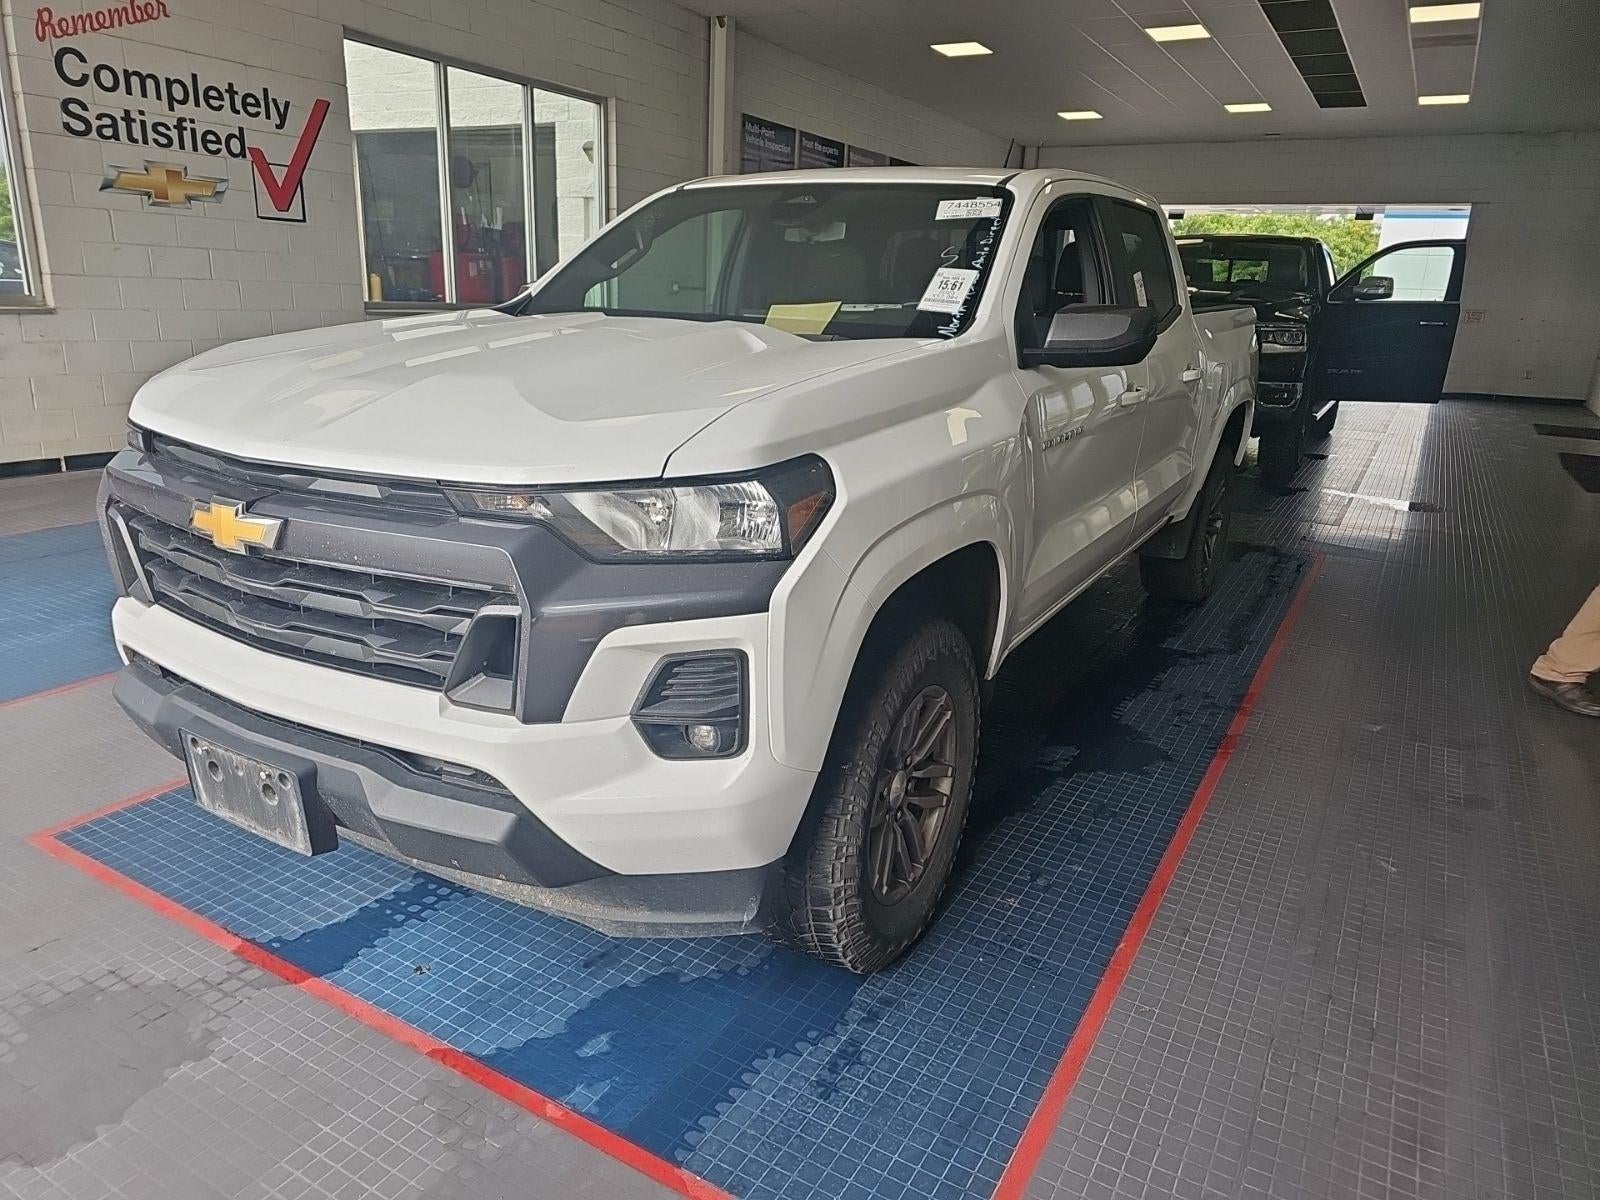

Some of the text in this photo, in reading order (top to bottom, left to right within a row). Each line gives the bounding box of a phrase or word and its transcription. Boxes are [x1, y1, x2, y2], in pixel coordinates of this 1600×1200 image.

[35, 0, 170, 42] Remember
[54, 46, 291, 130] Completely
[60, 97, 247, 159] Satisfied
[744, 121, 775, 138] Multi-Point
[745, 132, 791, 154] Vehicle Inspection
[802, 136, 814, 149] Trust
[822, 145, 839, 157] experts
[946, 201, 1001, 210] 7448554
